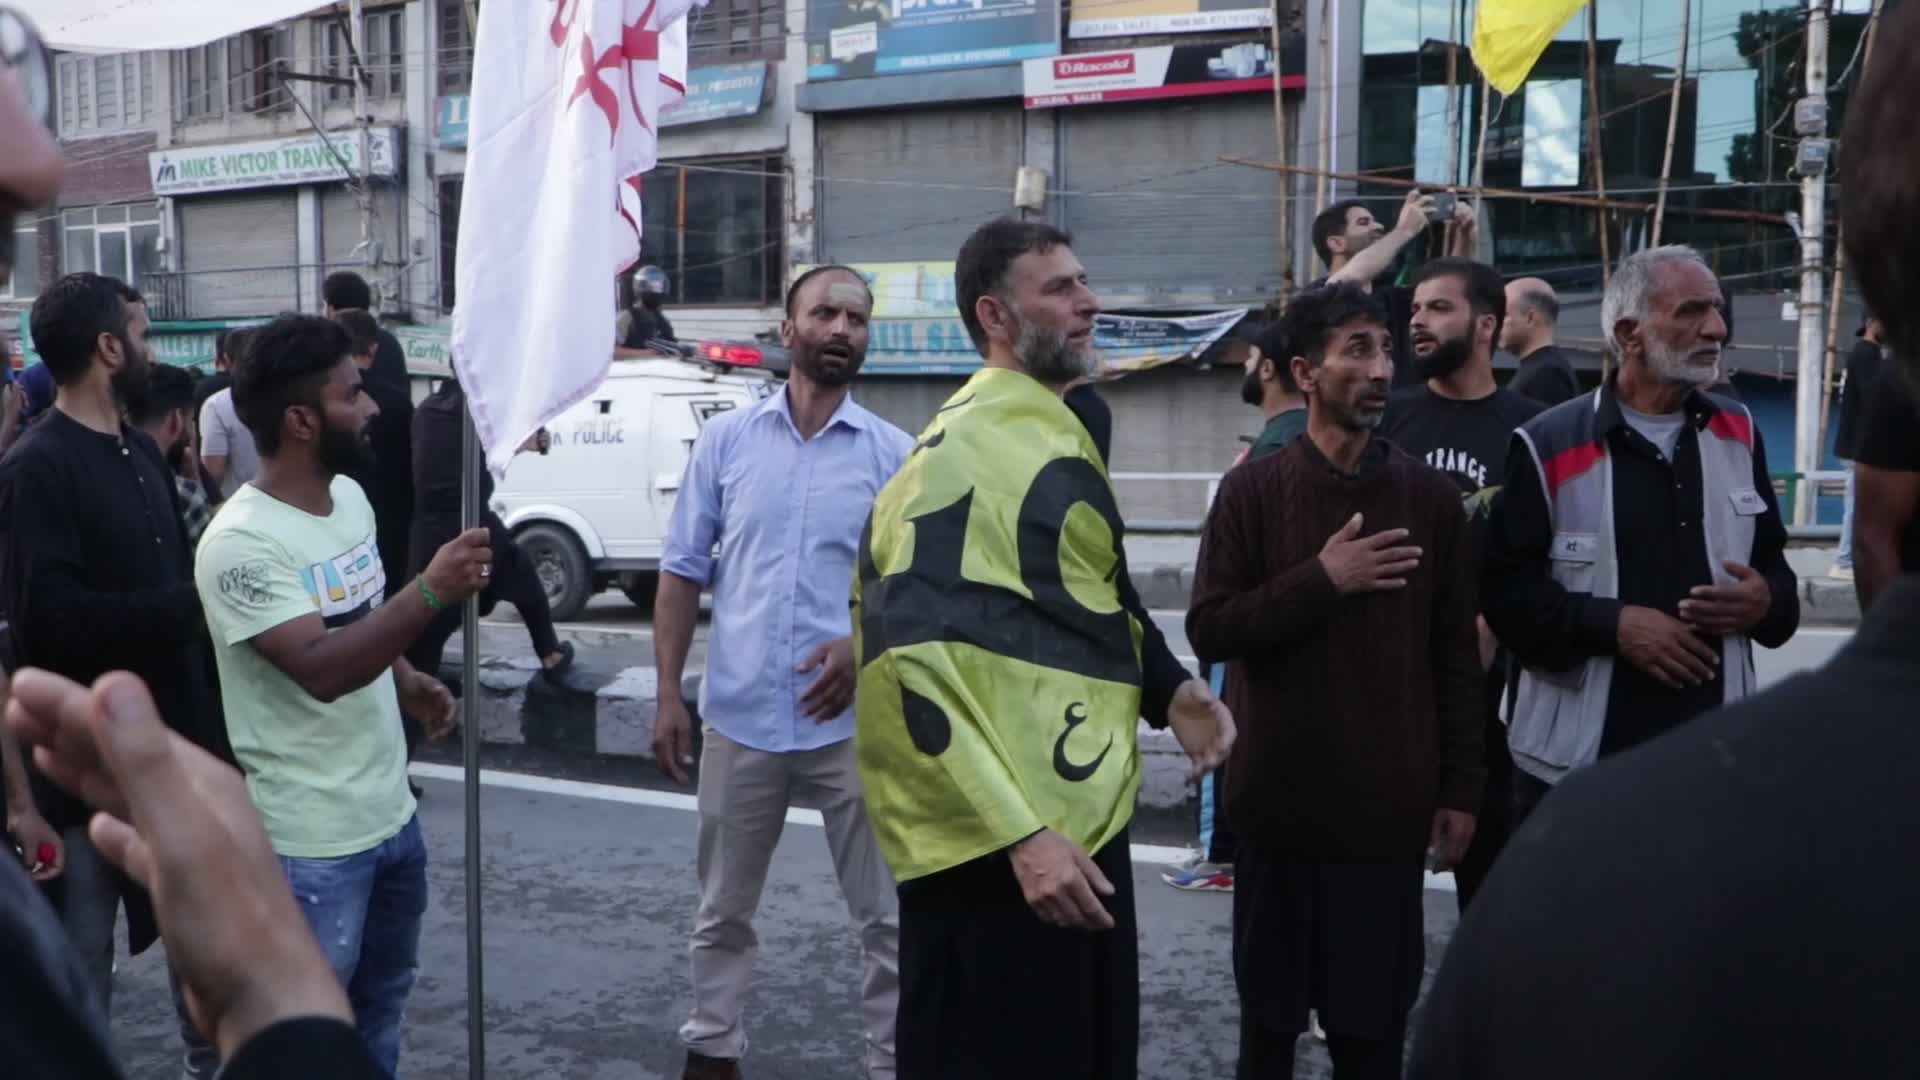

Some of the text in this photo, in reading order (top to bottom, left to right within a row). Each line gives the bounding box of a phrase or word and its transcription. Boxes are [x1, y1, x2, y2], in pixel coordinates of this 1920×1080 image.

[179, 157, 217, 179] MIKE
[219, 150, 280, 176] VICTOR
[572, 418, 625, 445] POLICE
